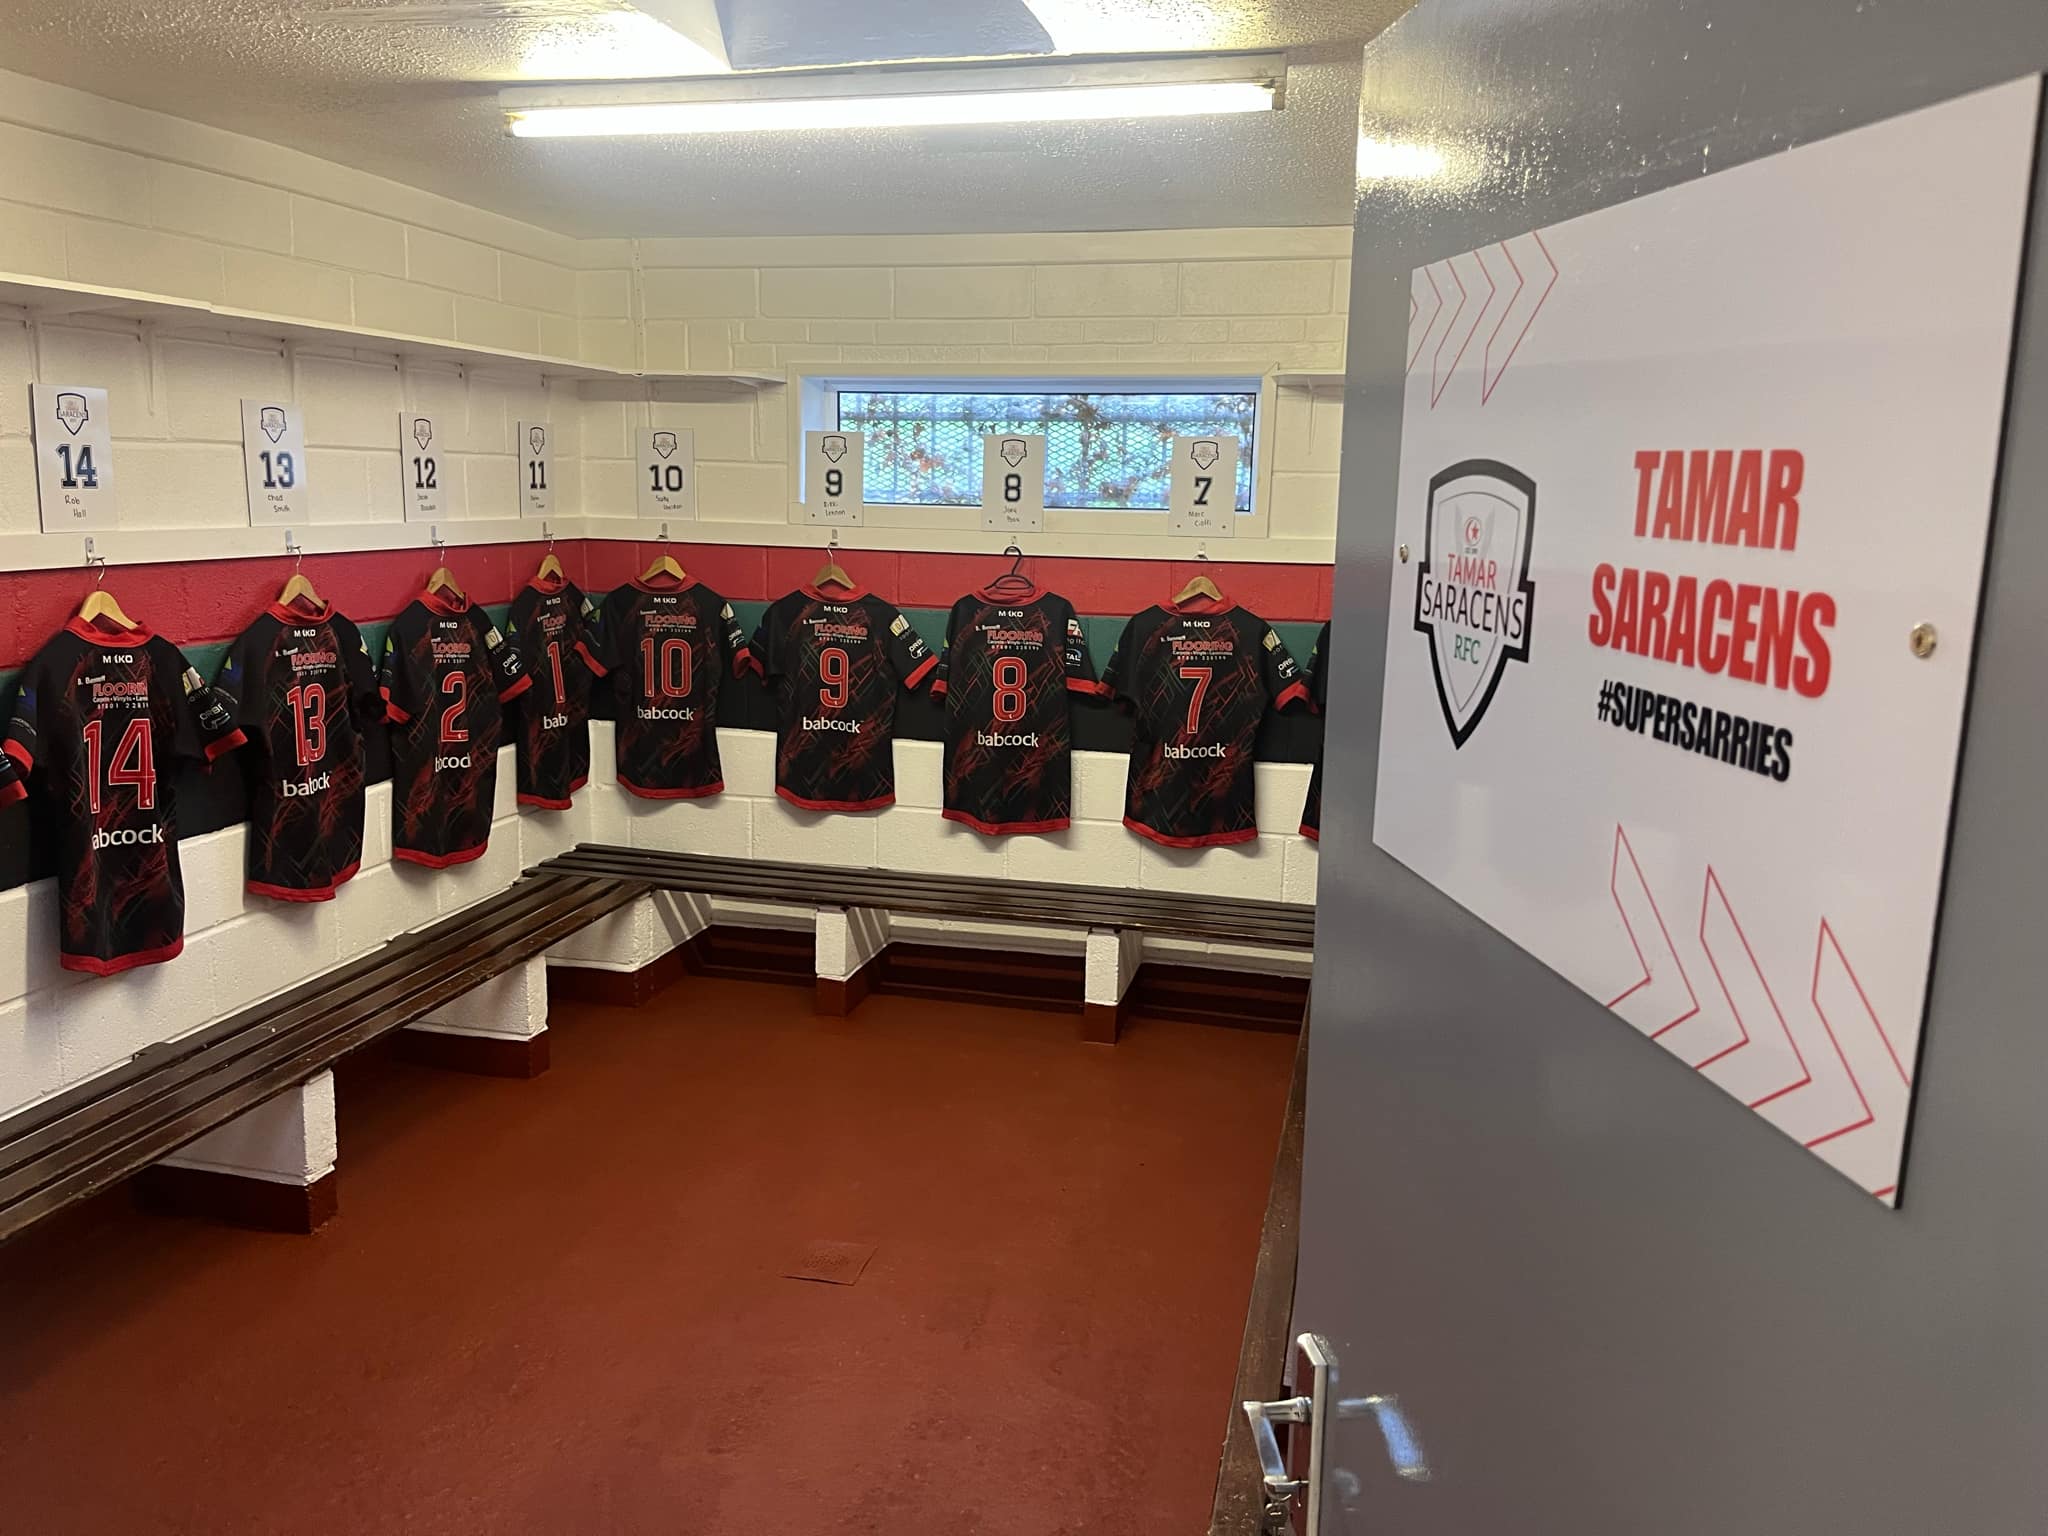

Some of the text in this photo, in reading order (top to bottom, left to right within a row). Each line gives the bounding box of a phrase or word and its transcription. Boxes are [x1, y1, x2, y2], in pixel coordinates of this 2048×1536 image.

[56, 443, 98, 489] 14
[259, 451, 294, 489] 13
[413, 457, 437, 489] 12
[529, 460, 546, 489] 11
[648, 464, 682, 492] 10
[825, 469, 842, 496] 9
[64, 494, 80, 504] Rob
[1004, 474, 1021, 501] 8
[1193, 476, 1212, 506] 7
[1633, 449, 1804, 551] TAMAR
[1447, 553, 1497, 590] TAMAR
[1422, 579, 1524, 640] SARACENS
[1453, 634, 1481, 665] RFC
[1588, 562, 1837, 700] SARACENS
[547, 641, 566, 704] 1
[640, 637, 692, 698] 10
[819, 647, 849, 708] 9
[441, 671, 469, 742] 2
[992, 656, 1027, 722] 8
[1179, 667, 1213, 734] 7
[286, 683, 326, 767] 13
[637, 704, 694, 721] babcock
[802, 716, 861, 734] babcock
[1597, 678, 1794, 783] #SUPERSARRIES
[977, 730, 1040, 748] babcock
[1164, 742, 1226, 760] babcock
[83, 718, 157, 814] 14
